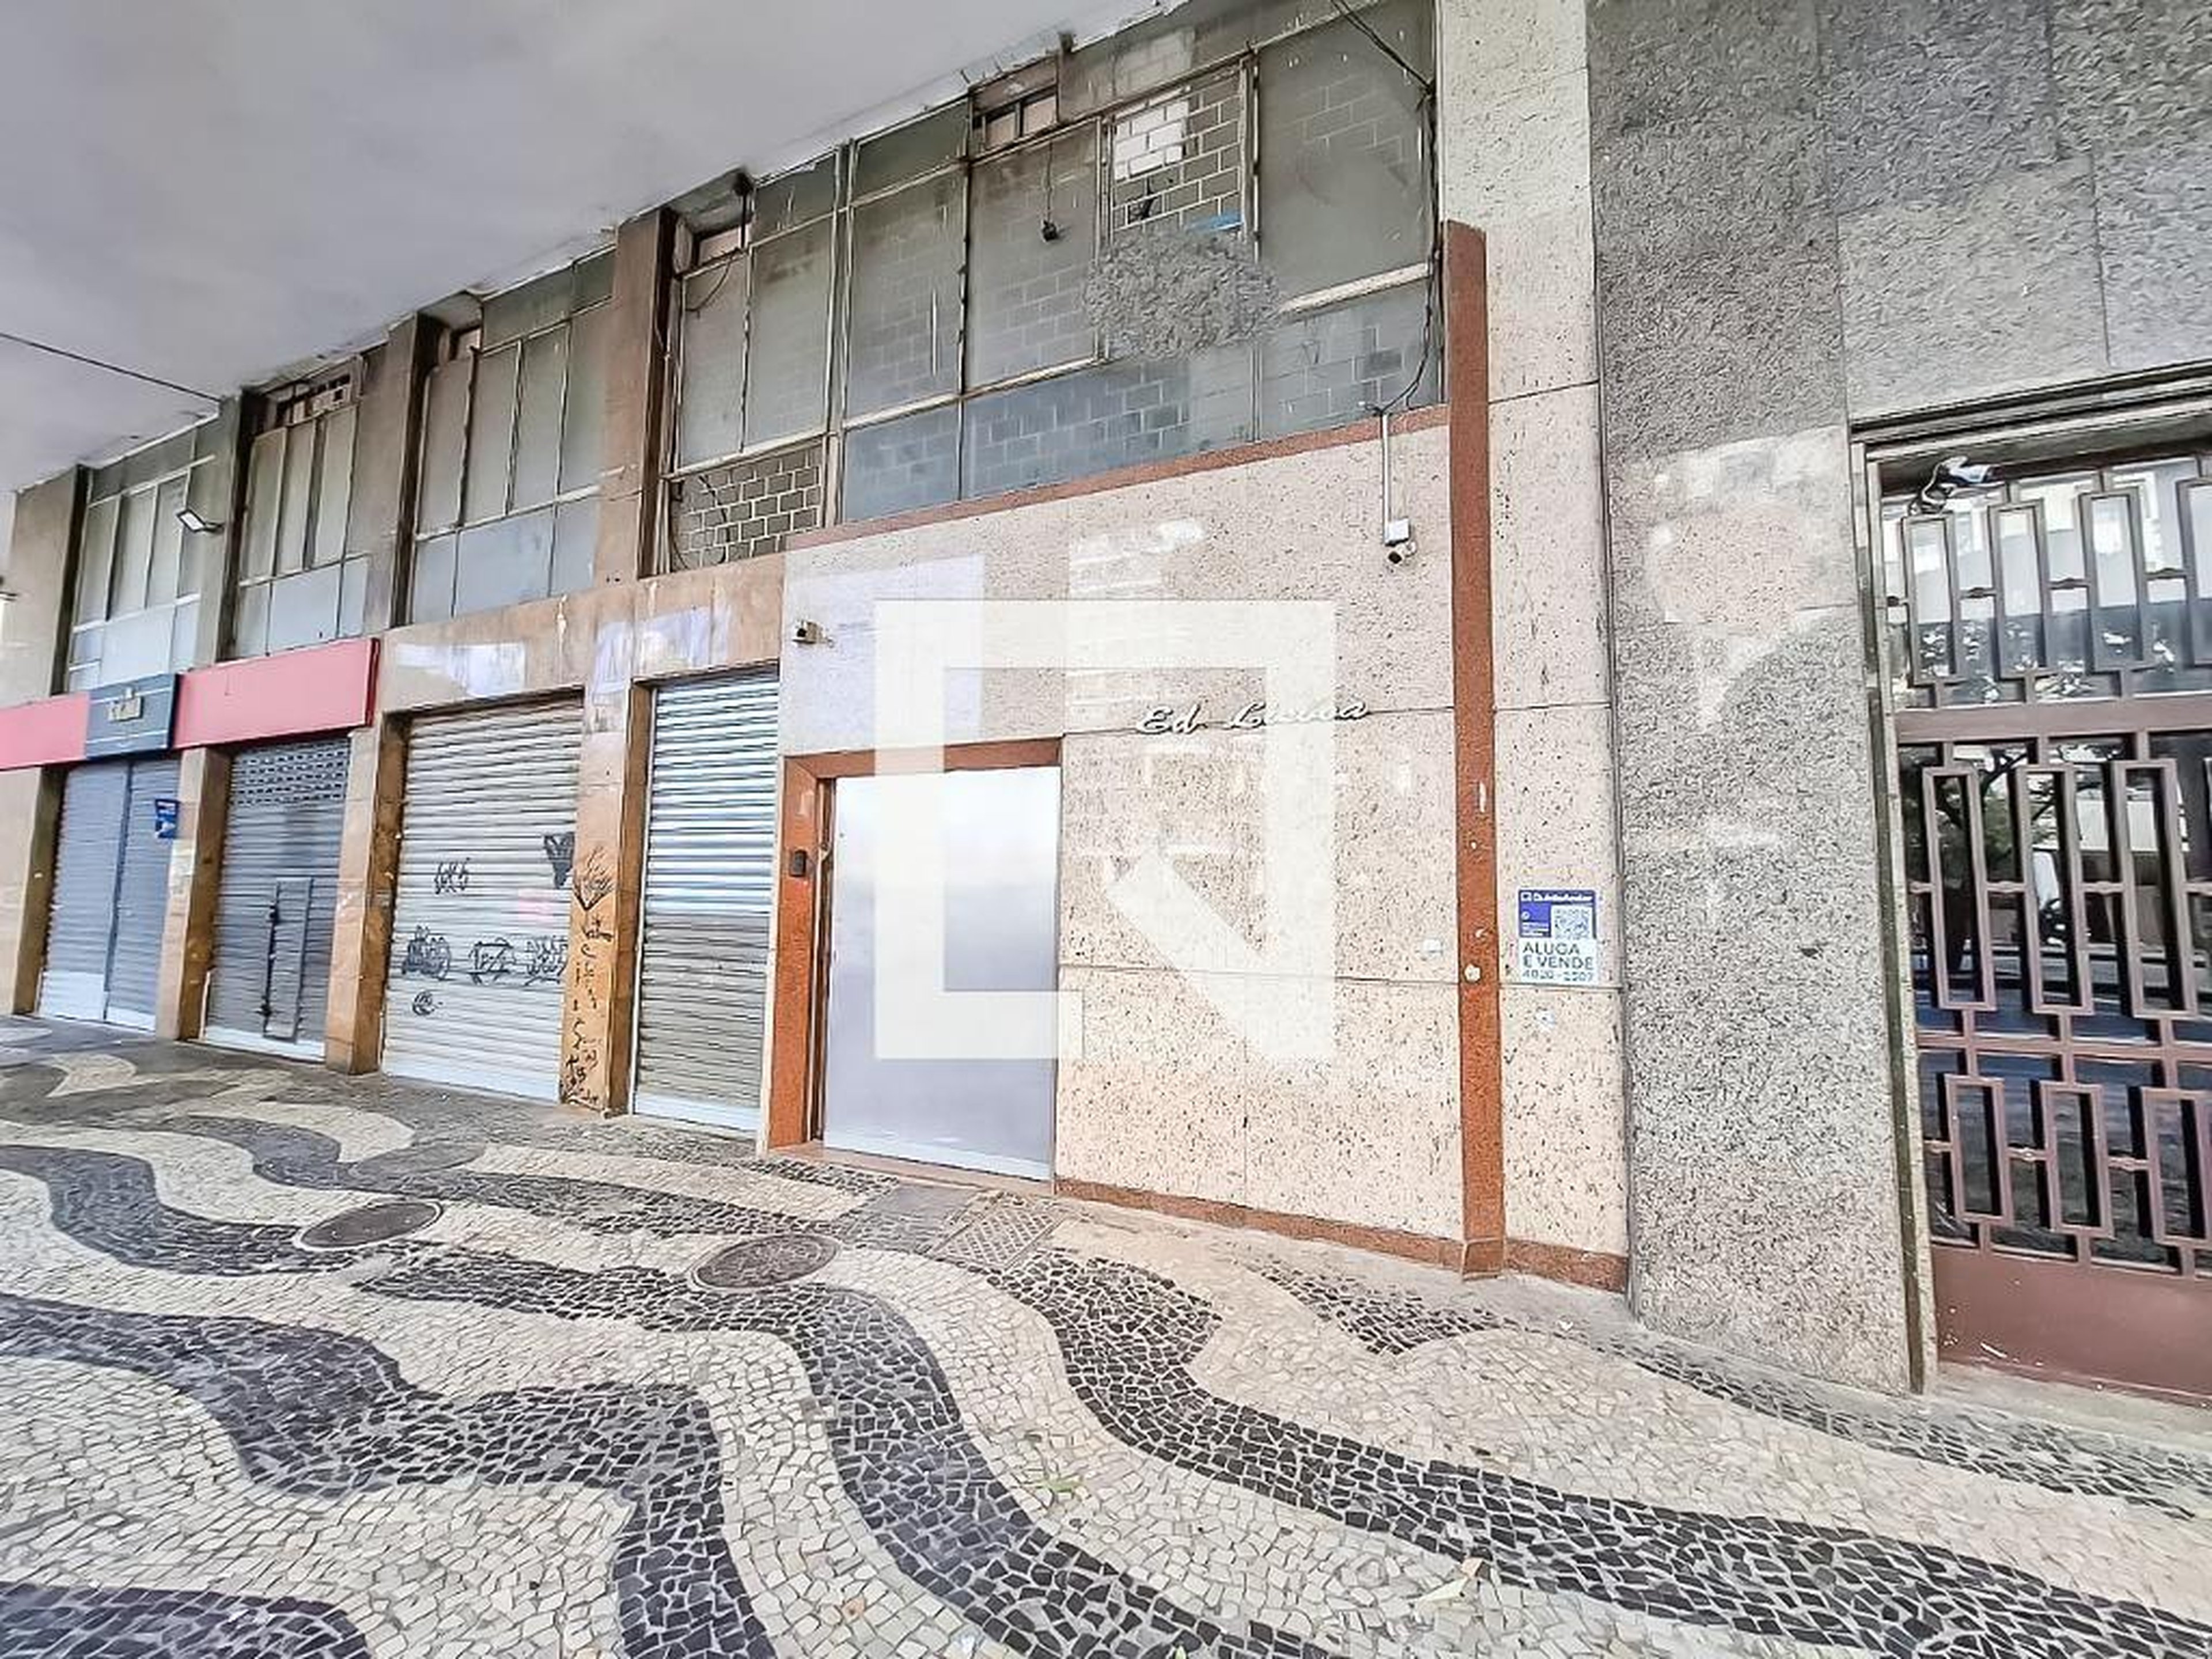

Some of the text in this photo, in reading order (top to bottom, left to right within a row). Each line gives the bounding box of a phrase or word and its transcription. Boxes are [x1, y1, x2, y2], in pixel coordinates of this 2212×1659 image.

[1522, 942, 1580, 955] ALUGA
[1523, 955, 1594, 970] E VENDE
